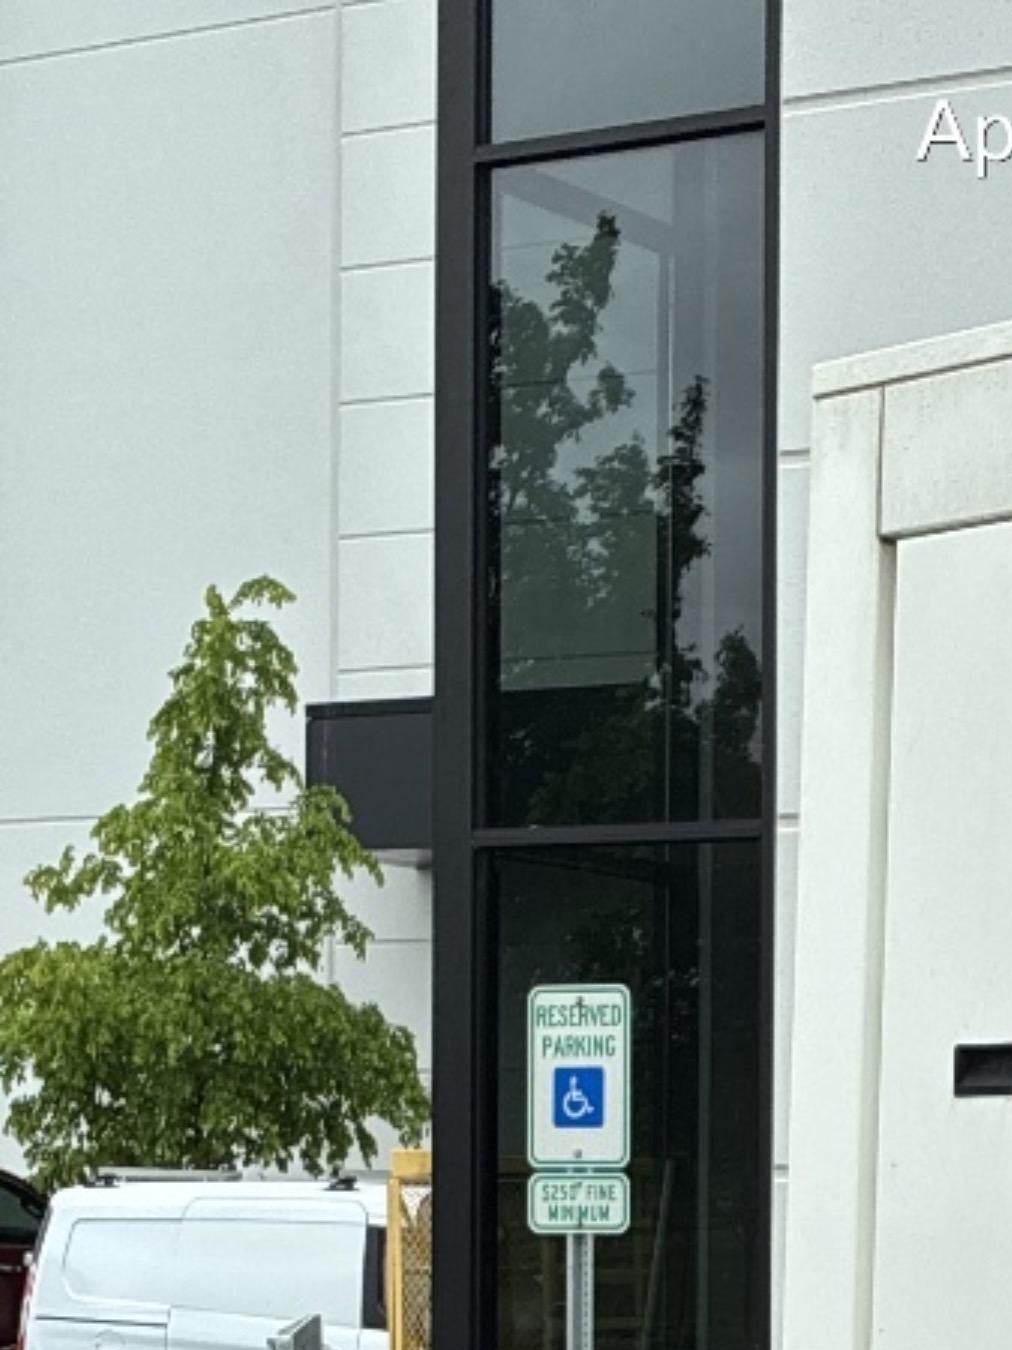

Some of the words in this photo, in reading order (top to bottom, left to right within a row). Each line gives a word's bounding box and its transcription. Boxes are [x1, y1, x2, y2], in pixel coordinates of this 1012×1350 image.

[536, 1004, 622, 1028] RESERVED
[542, 1034, 616, 1058] PARKING
[586, 1183, 616, 1202] FINE
[548, 1204, 610, 1223] MINIMUM
